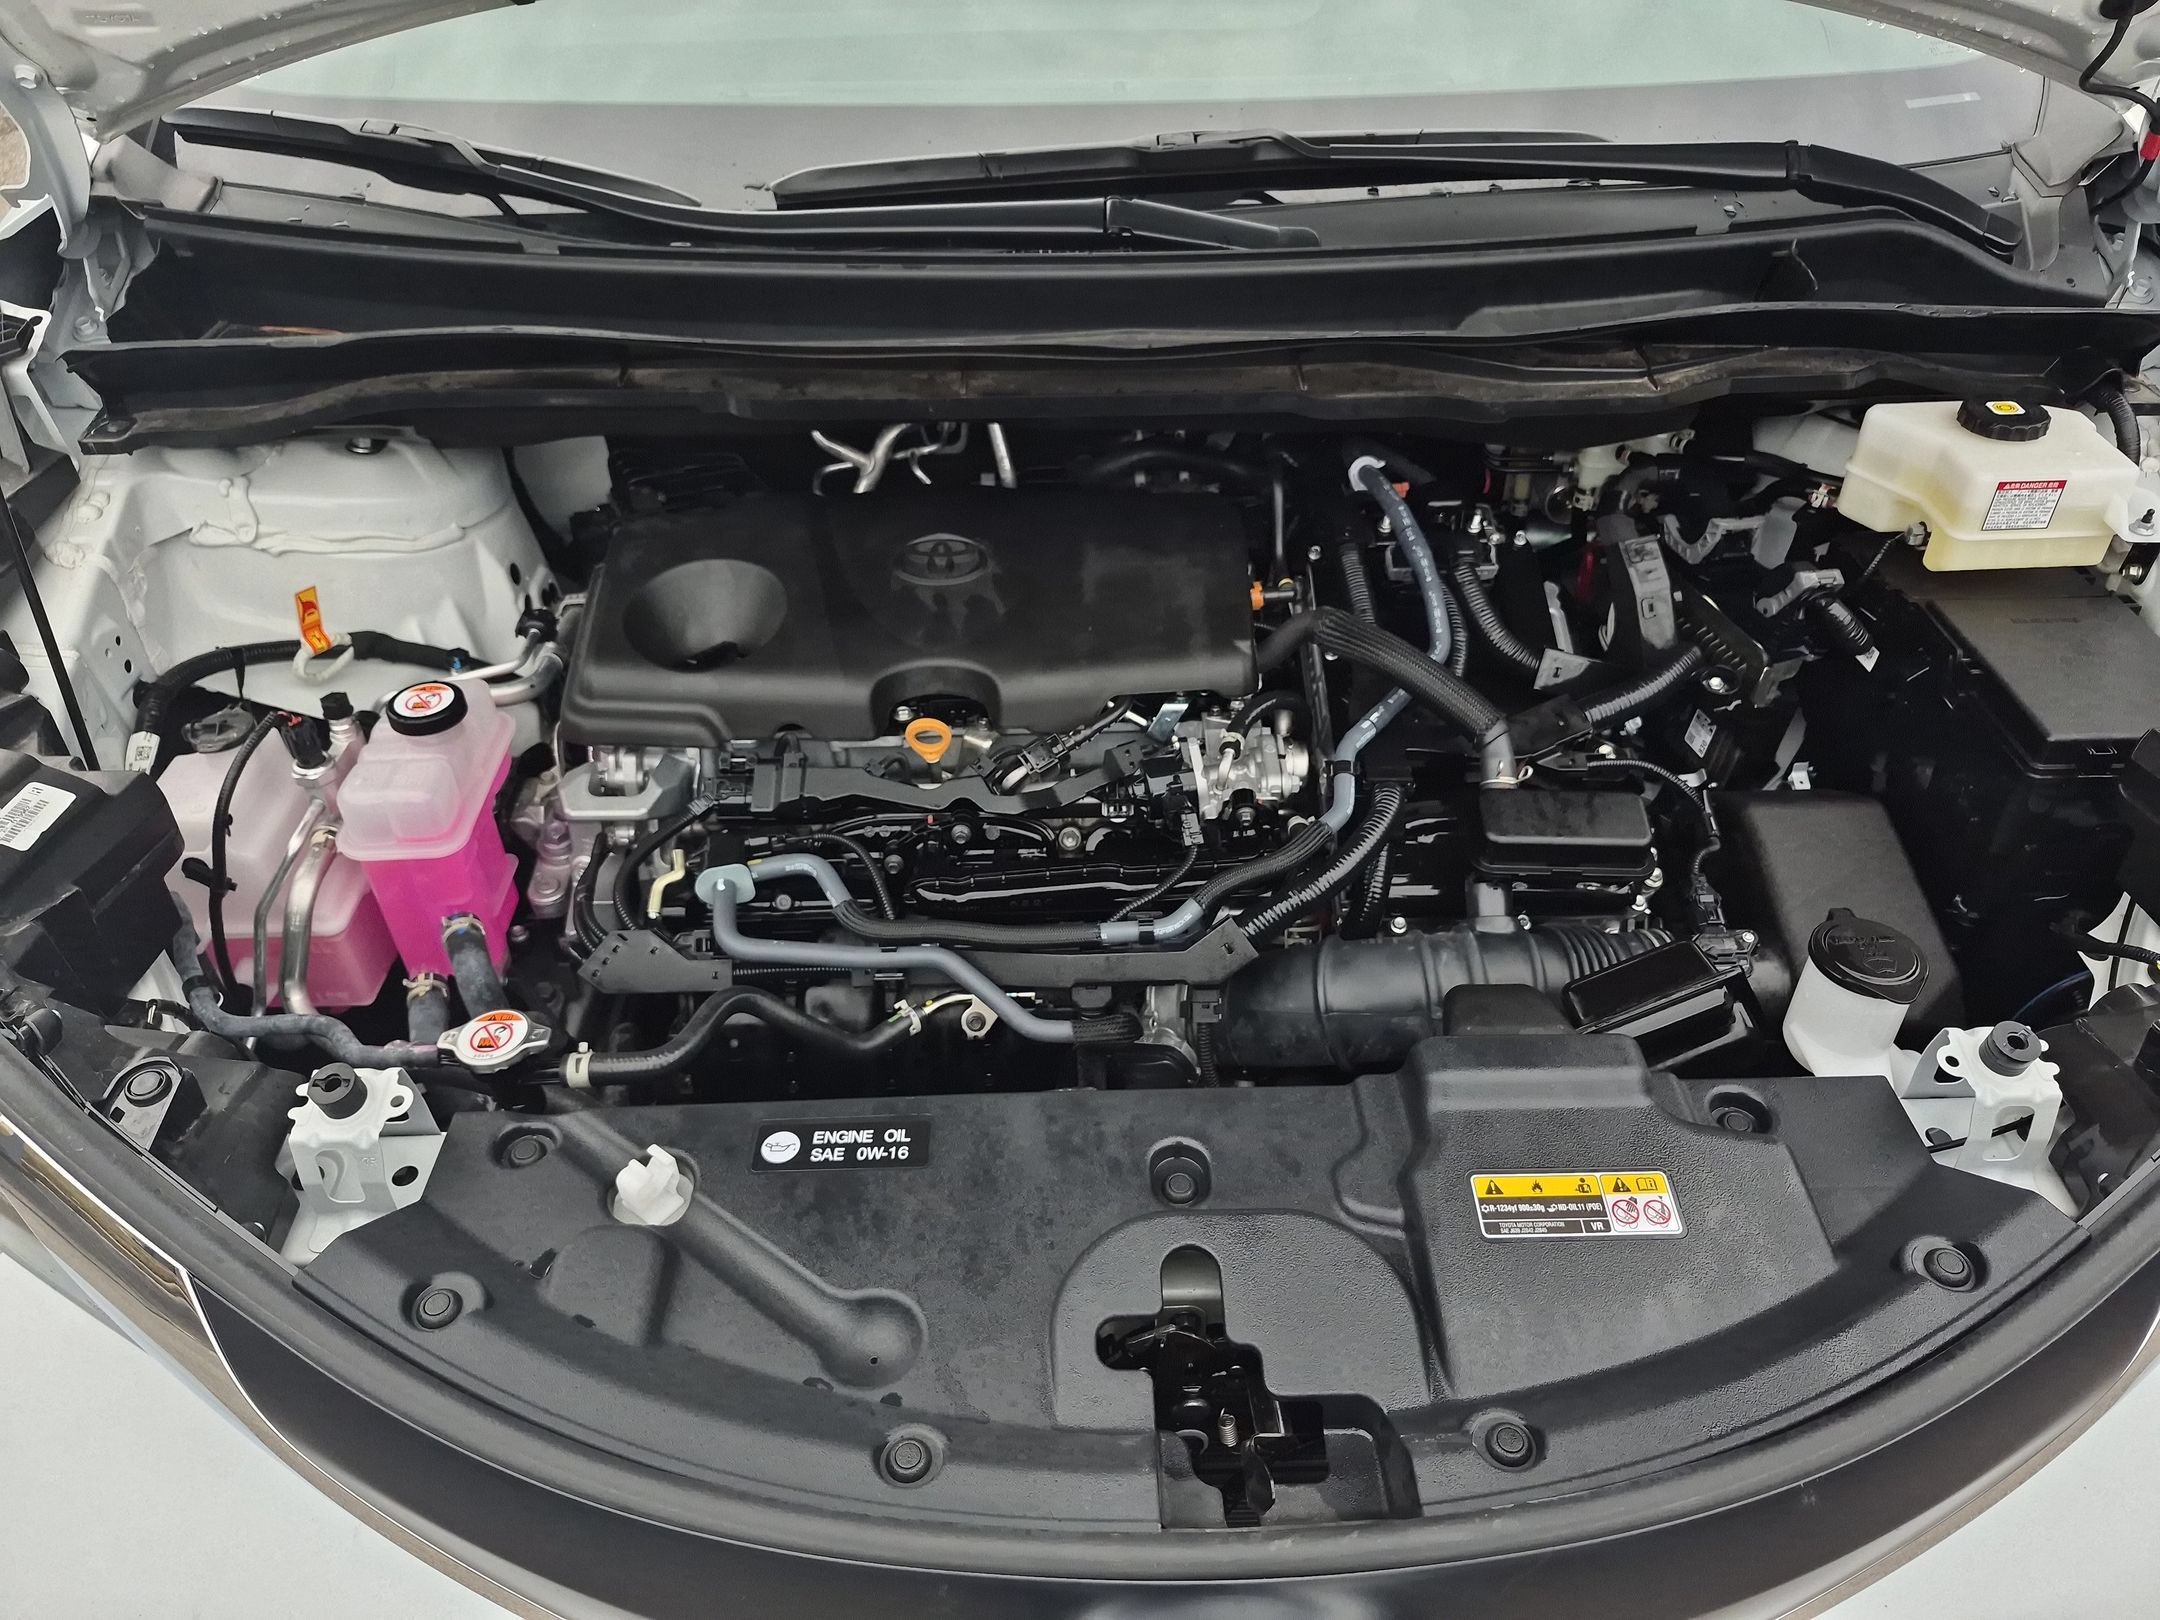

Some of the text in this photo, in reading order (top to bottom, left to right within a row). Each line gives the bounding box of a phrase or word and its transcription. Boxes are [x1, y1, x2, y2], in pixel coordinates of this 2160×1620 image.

[812, 1128, 911, 1144] ENGINE OIL
[810, 1146, 909, 1162] SAE 0W-16
[1590, 1221, 1604, 1230] VR
